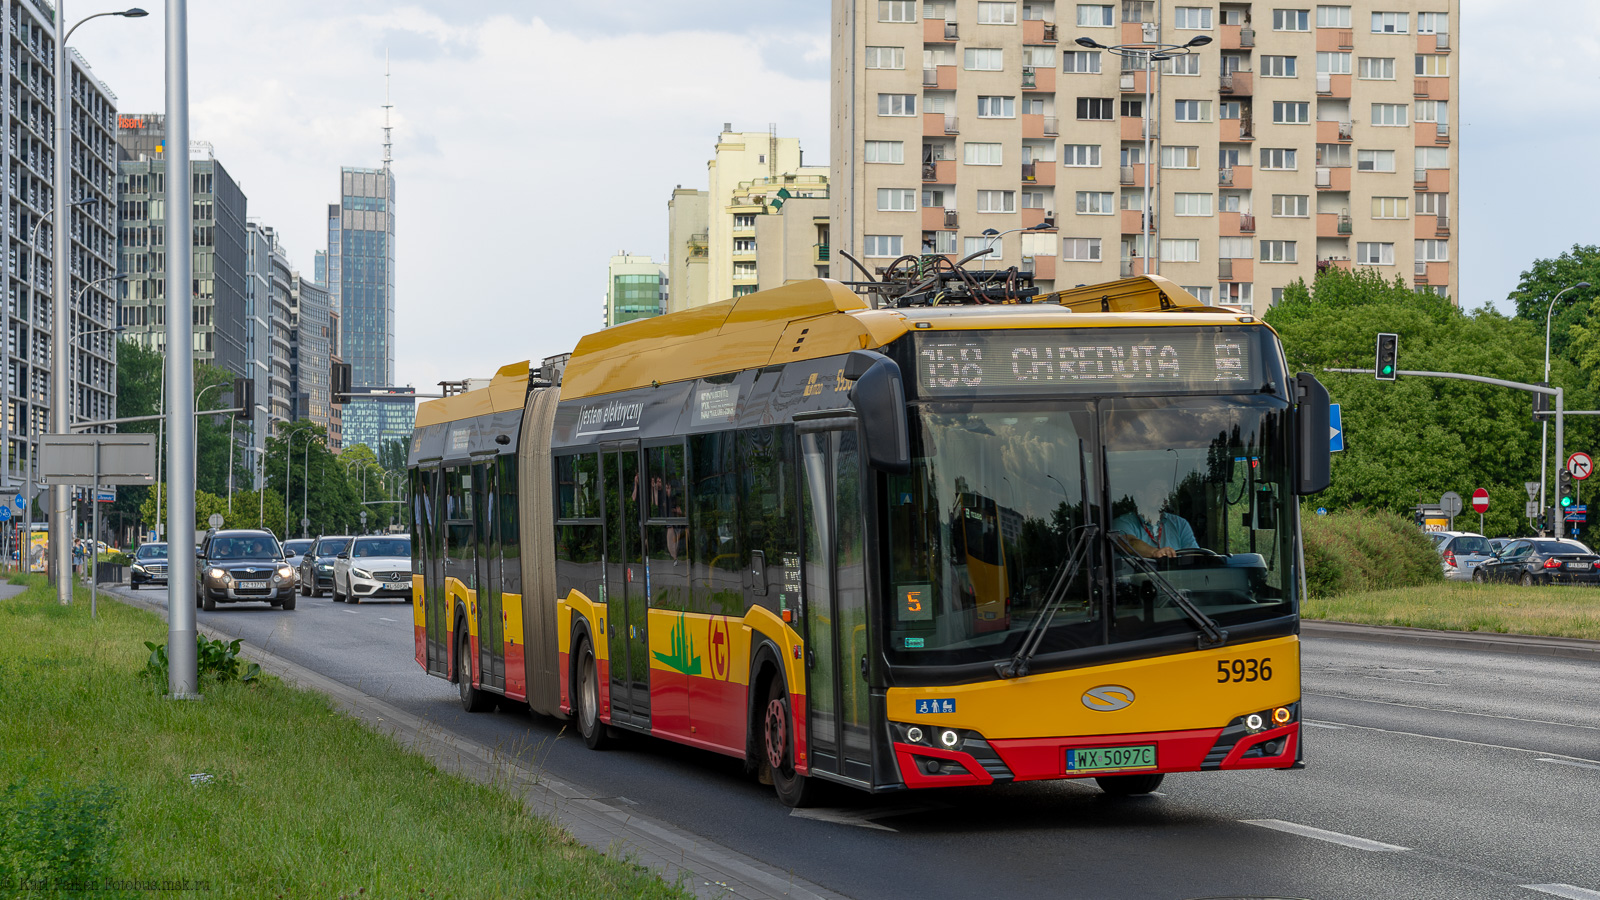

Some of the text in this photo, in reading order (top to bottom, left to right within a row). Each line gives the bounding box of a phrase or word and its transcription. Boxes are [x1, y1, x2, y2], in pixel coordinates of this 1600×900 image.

[920, 343, 983, 388] 158
[580, 400, 645, 431] jestem elektryczny
[907, 591, 921, 612] 5
[1217, 658, 1273, 684] 5936
[1078, 751, 1098, 767] WX
[1104, 748, 1151, 766] 5097C
